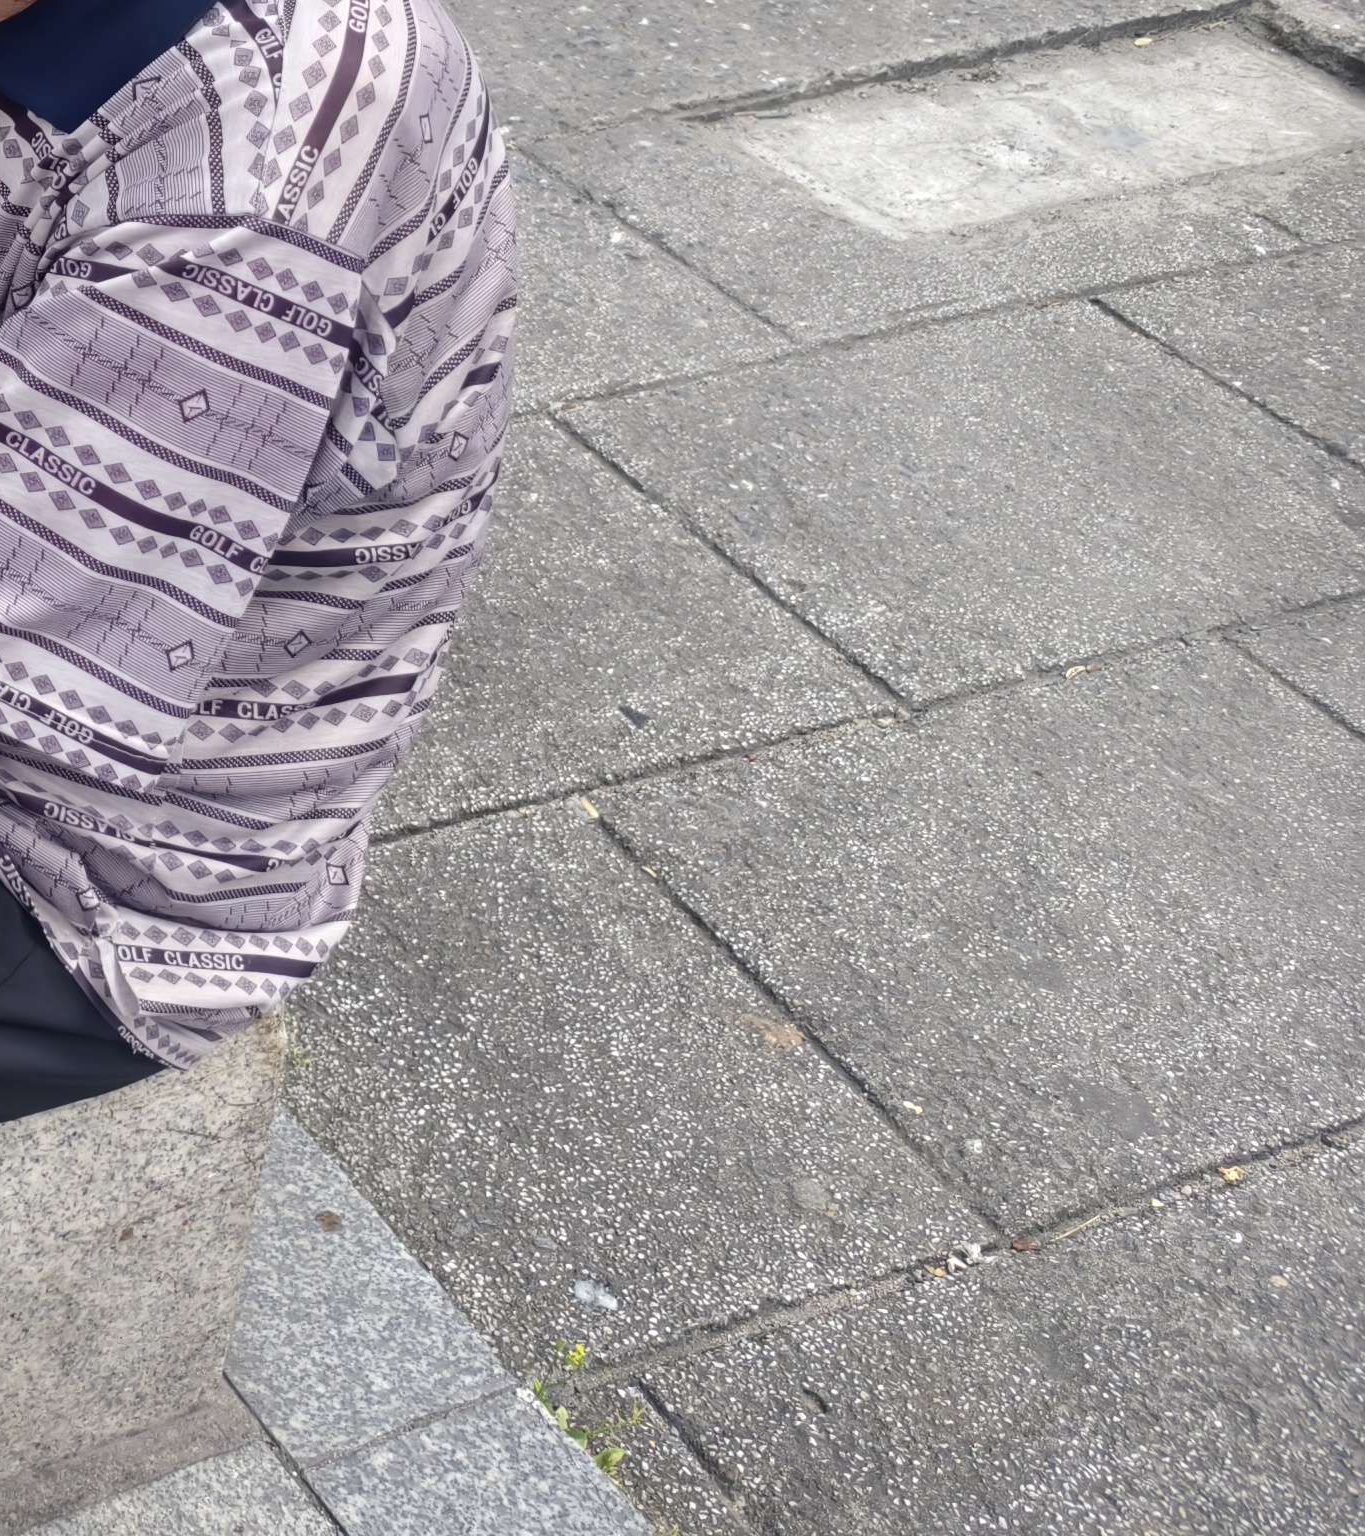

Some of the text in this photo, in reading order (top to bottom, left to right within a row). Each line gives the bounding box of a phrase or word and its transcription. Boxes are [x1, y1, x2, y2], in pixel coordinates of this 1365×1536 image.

[276, 145, 319, 226] ASSIC
[453, 157, 479, 210] GOLF
[181, 264, 333, 337] GOLF CLASSIC
[5, 430, 96, 496] CLASSIC
[189, 525, 244, 559] GOLF
[38, 708, 95, 745] GOLF
[164, 950, 245, 972] CLASSIC
